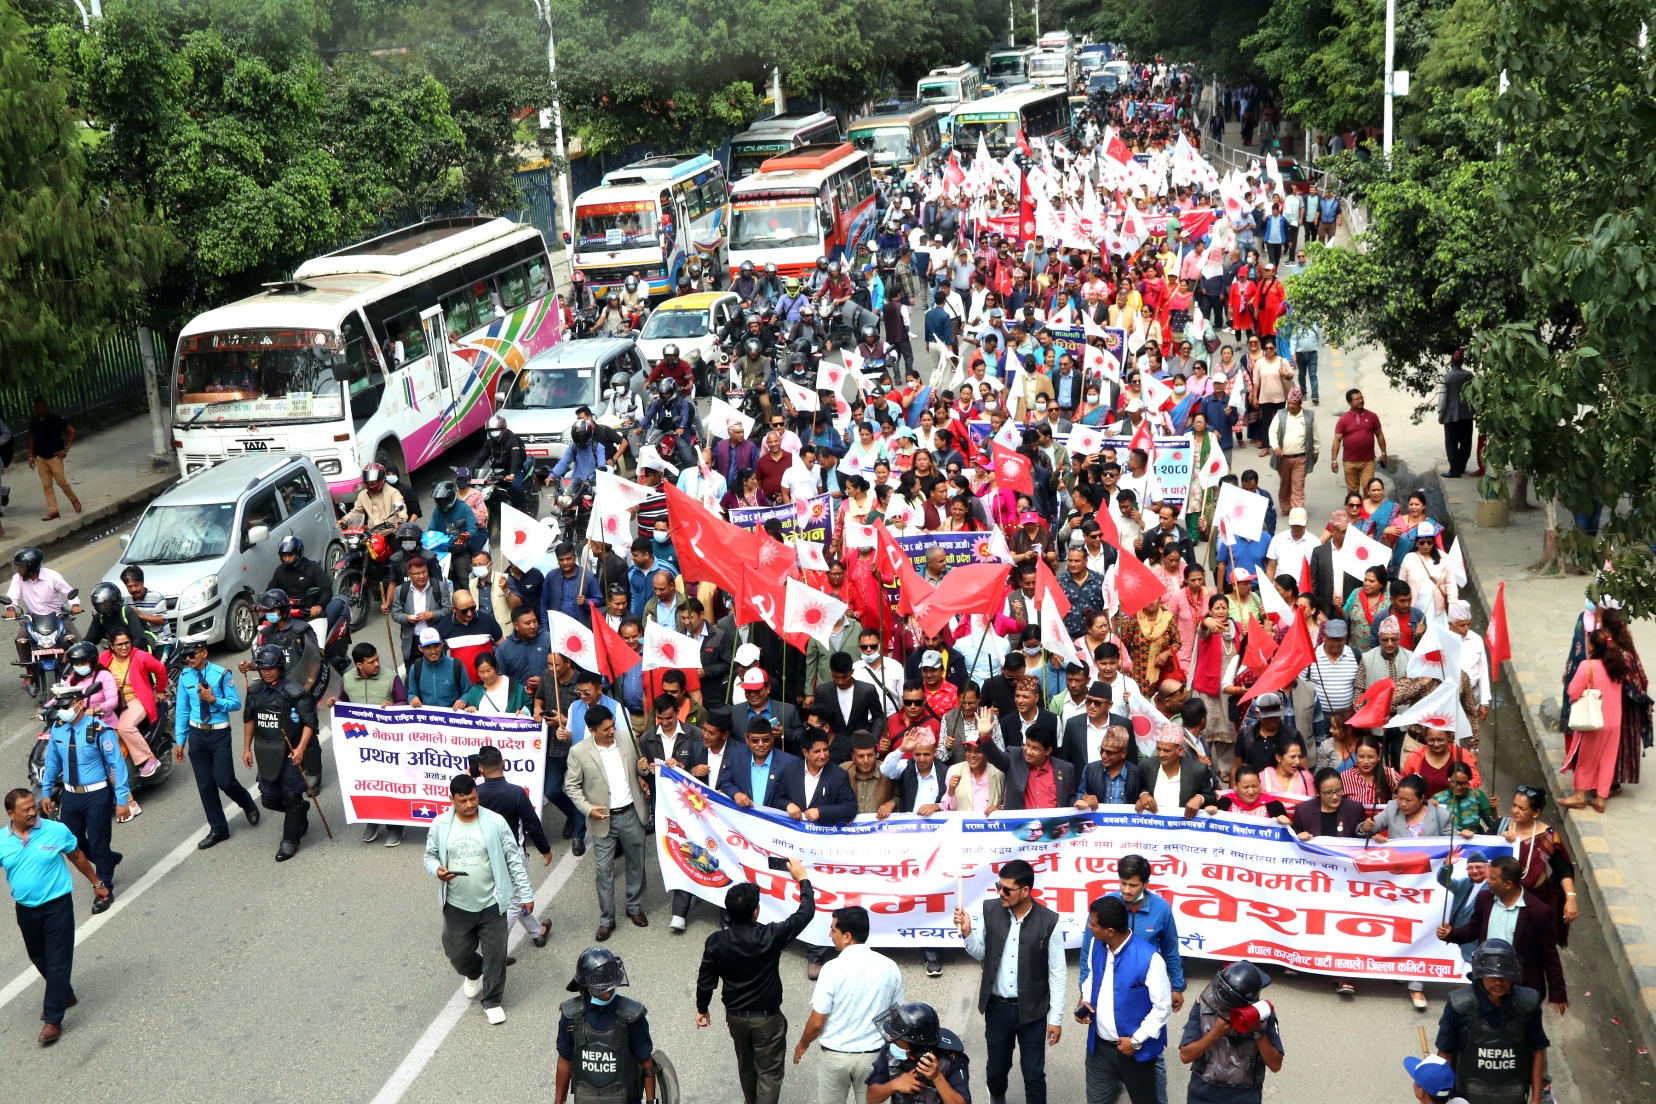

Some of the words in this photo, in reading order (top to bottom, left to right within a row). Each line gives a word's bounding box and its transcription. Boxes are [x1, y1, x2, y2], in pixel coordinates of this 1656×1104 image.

[736, 144, 783, 152] TOURIST
[243, 442, 268, 450] TATA
[258, 712, 278, 721] NEPAL
[258, 720, 278, 728] POLICE
[372, 728, 404, 742] नेकपा
[408, 728, 448, 744] (एमाले)
[450, 736, 493, 747] बागमती
[496, 736, 525, 750] प्रदेश
[359, 747, 400, 766] प्रथम
[407, 748, 468, 771] अधिवेश
[503, 758, 535, 772] ०८०
[424, 772, 446, 780] असोज
[354, 779, 416, 795] भव्यताका
[772, 836, 794, 850] असोज
[1018, 844, 1048, 852] अध्यक्ष
[1094, 840, 1114, 848] शर्मा
[1212, 846, 1224, 858] हुने
[1230, 850, 1276, 864] समारोहमा
[1202, 863, 1335, 893] बागमती
[1347, 879, 1435, 904] प्रदेश
[1247, 943, 1272, 956] नेपाल
[1274, 949, 1312, 966] कम्युनिष्ट
[1314, 952, 1332, 968] पार्टी
[1334, 956, 1364, 970] (एमाले)
[1366, 958, 1394, 972] जिल्ला
[1397, 960, 1426, 974] कमिटी
[1428, 964, 1452, 978] रसुवा
[582, 1050, 616, 1062] NEPAL
[1478, 1047, 1516, 1058] NEPAL
[582, 1061, 616, 1072] POLICE
[1478, 1058, 1516, 1070] POLICE
